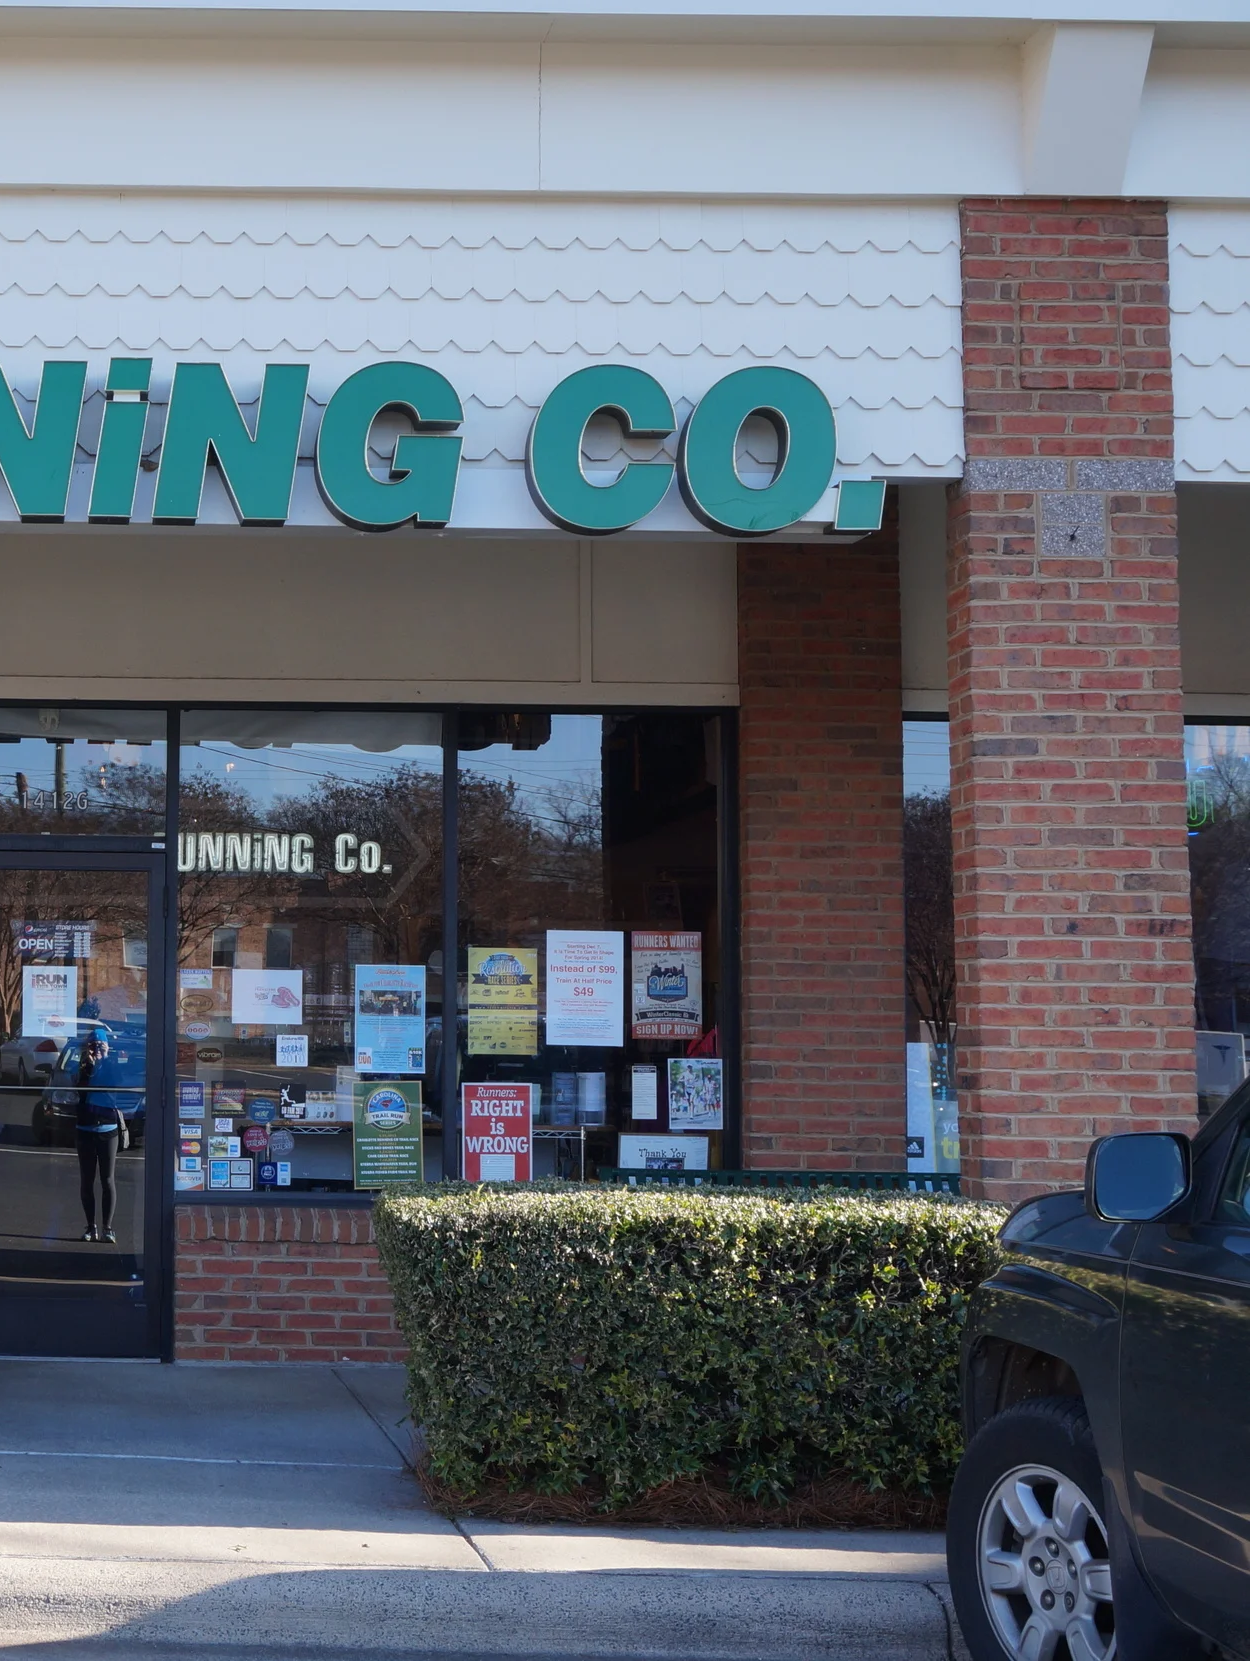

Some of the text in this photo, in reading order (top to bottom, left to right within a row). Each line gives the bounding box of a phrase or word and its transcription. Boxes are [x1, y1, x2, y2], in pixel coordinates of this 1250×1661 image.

[530, 364, 887, 534] CO.
[22, 791, 88, 810] 1412G
[18, 938, 54, 950] OPEN
[634, 934, 699, 948] RUNNERS WANTED
[477, 961, 528, 977] Resolution
[550, 964, 618, 975] Instead of $99,
[573, 986, 594, 997] $49
[636, 1024, 699, 1035] SIGN UP NOW!
[197, 1051, 222, 1059] vibram
[373, 1092, 402, 1104] CAROLINA
[476, 1086, 518, 1098] Runners:
[470, 1100, 525, 1117] RIGHT
[490, 1117, 505, 1135] is
[465, 1136, 529, 1154] WRONG
[638, 1147, 687, 1158] Thank You
